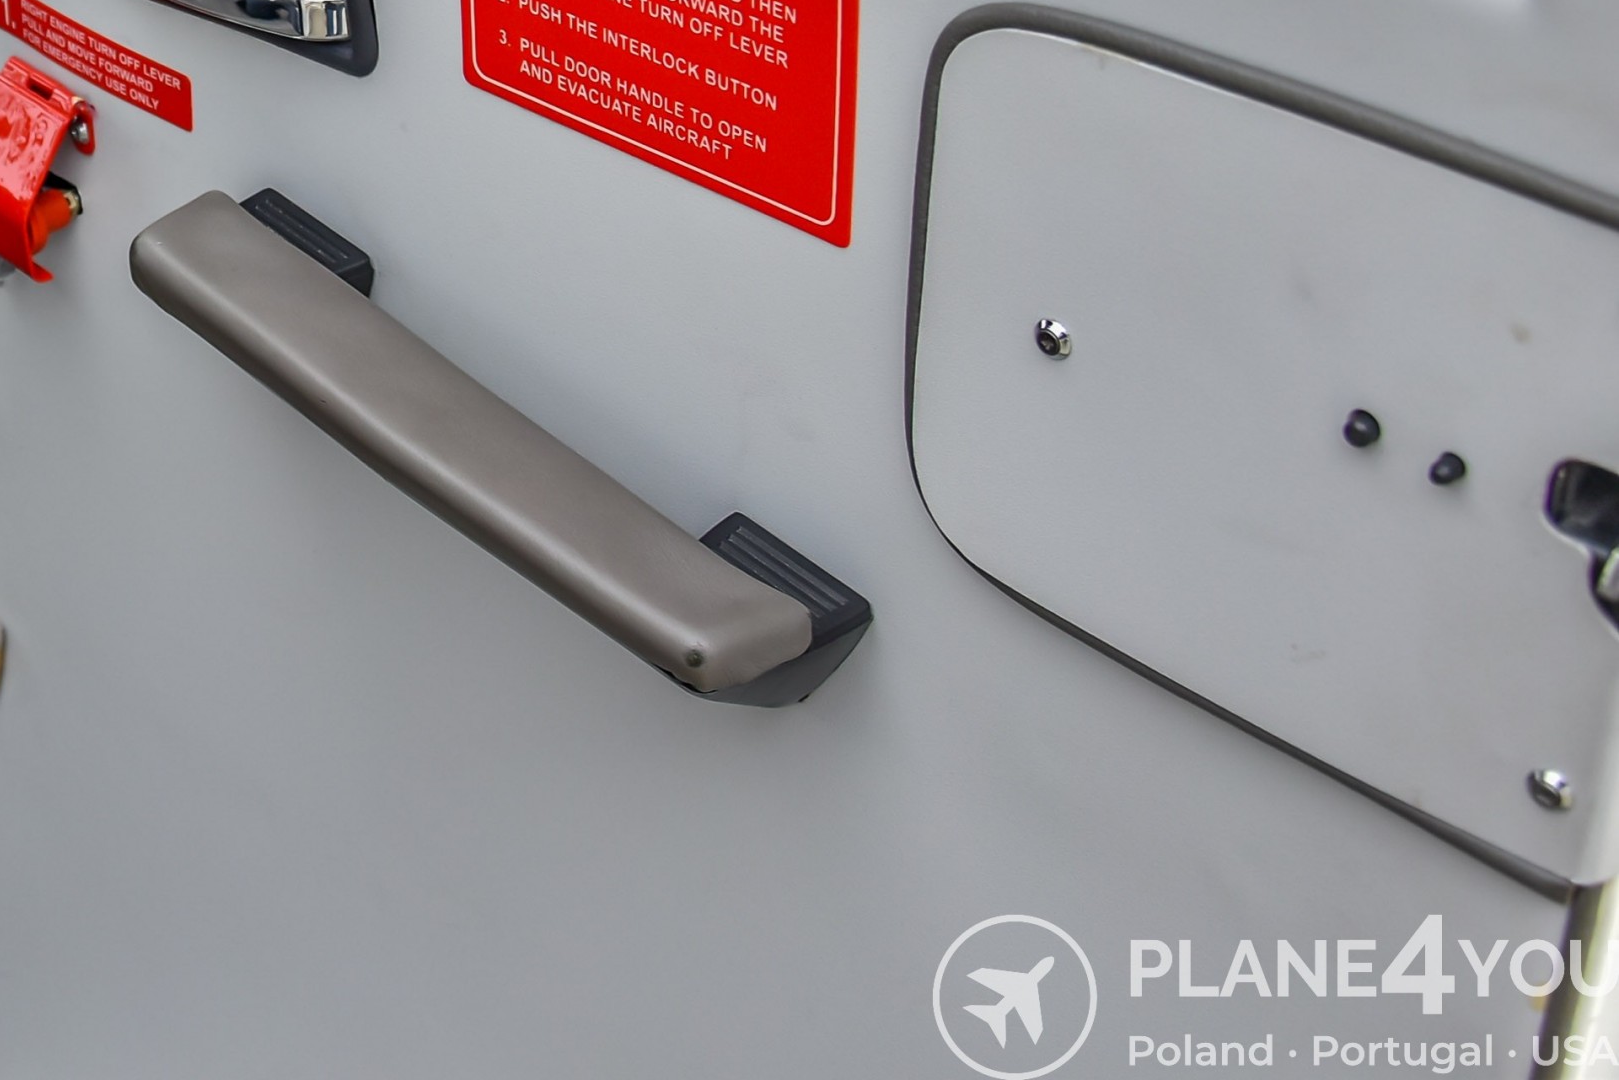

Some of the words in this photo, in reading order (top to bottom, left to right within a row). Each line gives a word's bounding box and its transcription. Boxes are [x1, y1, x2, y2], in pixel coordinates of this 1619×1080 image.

[21, 12, 44, 36] PULL
[45, 28, 66, 49] AND
[67, 41, 96, 66] MOVE
[98, 57, 154, 93] FORWARD
[23, 28, 42, 48] FOR
[43, 41, 103, 83] EMERGENCY
[105, 76, 127, 96] USE
[129, 88, 160, 111] ONLY
[50, 14, 86, 45] ENGINE
[87, 35, 116, 60] TURN
[118, 52, 141, 71] OFF
[142, 63, 182, 91] LEVER
[566, 12, 598, 39] THE
[602, 27, 700, 80] INTERLOCK
[705, 69, 778, 112] BUTTON
[689, 17, 724, 41] OFF
[729, 32, 788, 69] LEVER
[748, 15, 785, 43] THE
[498, 29, 512, 47] 3.
[520, 37, 560, 68] PULL
[564, 56, 612, 89] DOOR
[616, 77, 685, 119] HANDLE
[689, 107, 713, 130] TO
[718, 120, 767, 153] OPEN
[520, 59, 553, 85] AND
[557, 75, 642, 123] EVACUATE
[646, 113, 732, 160] AIRCRAFT
